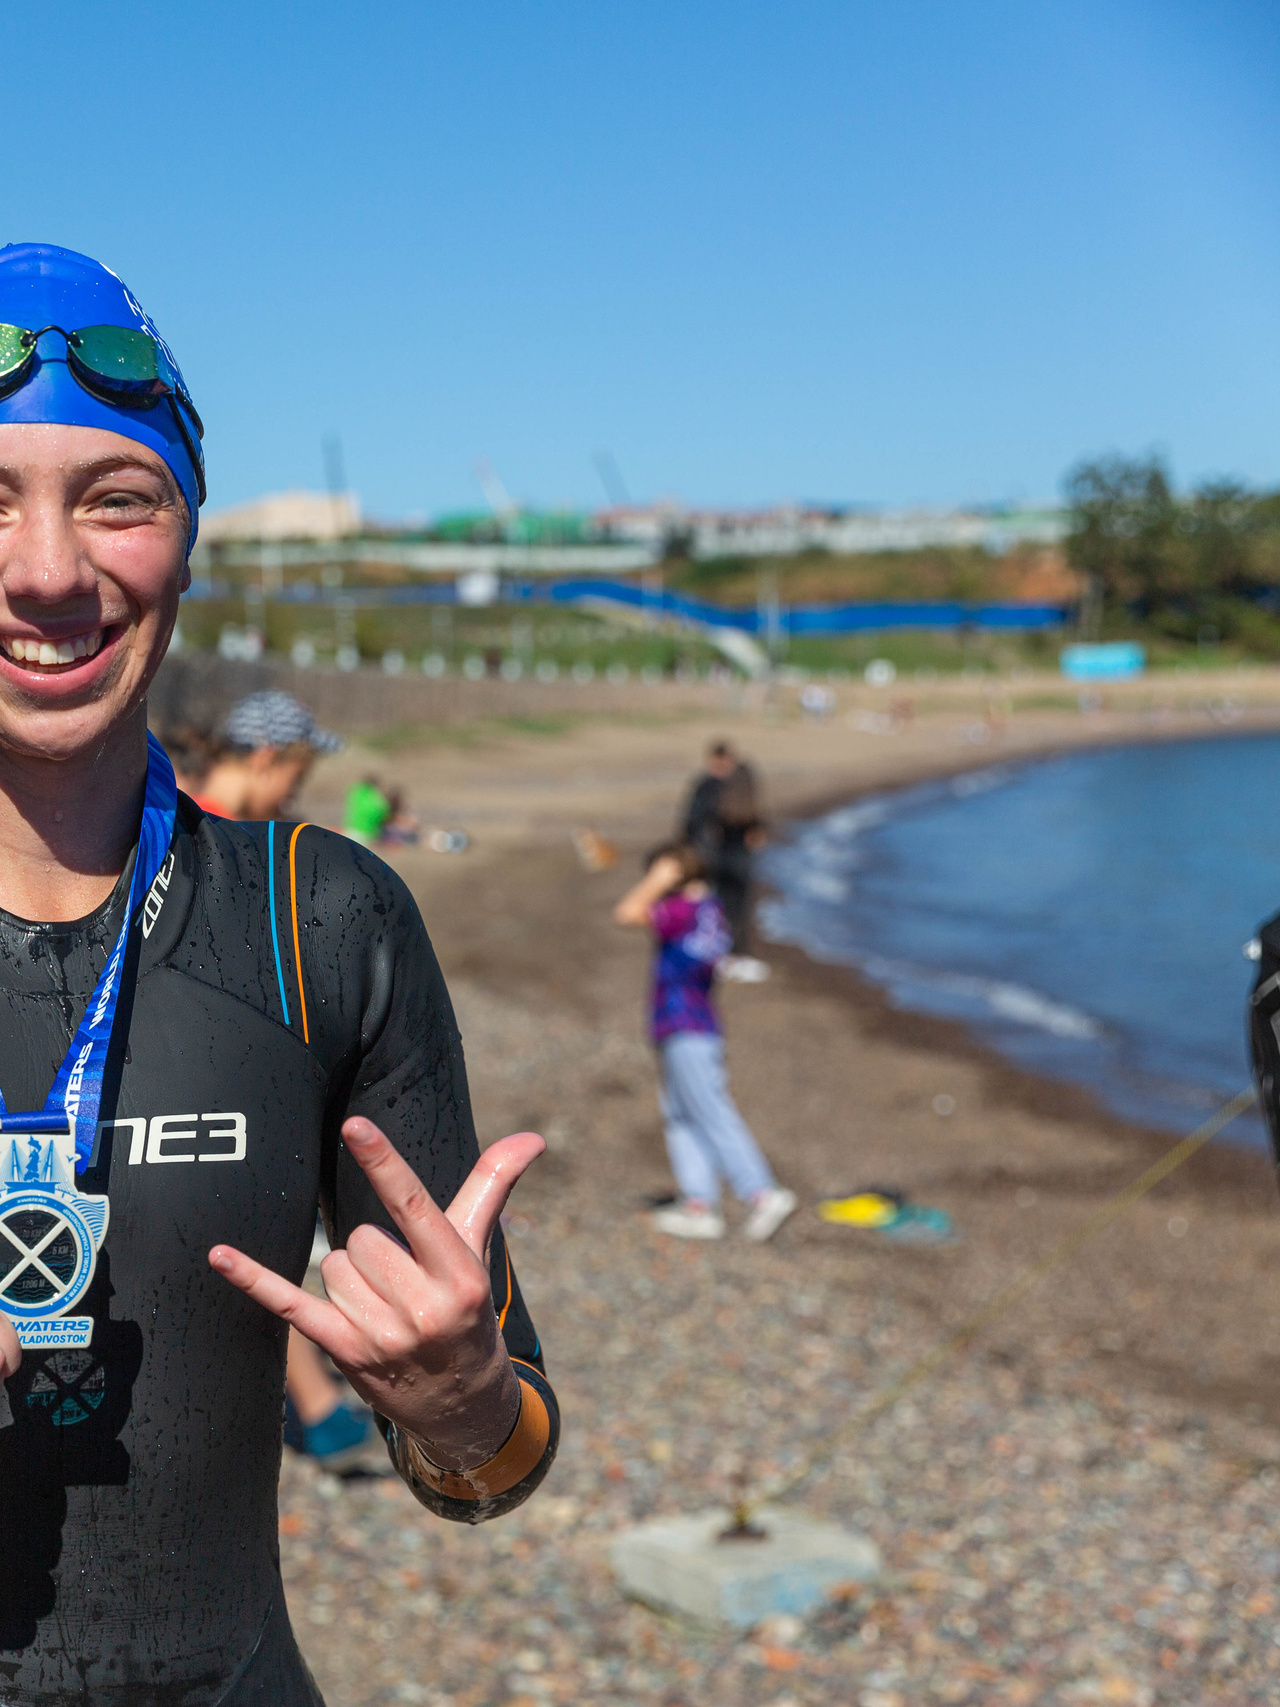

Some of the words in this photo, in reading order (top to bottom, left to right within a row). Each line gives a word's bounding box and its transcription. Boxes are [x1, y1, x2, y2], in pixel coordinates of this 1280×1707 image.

[63, 1041, 94, 1123] ATERS
[88, 952, 120, 1030] WORLD
[62, 1208, 90, 1251] CHAMPIONSHIP
[58, 1246, 69, 1255] KM
[82, 1252, 90, 1273] WORLD
[39, 1279, 46, 1288] M
[11, 1320, 90, 1332] WATERS
